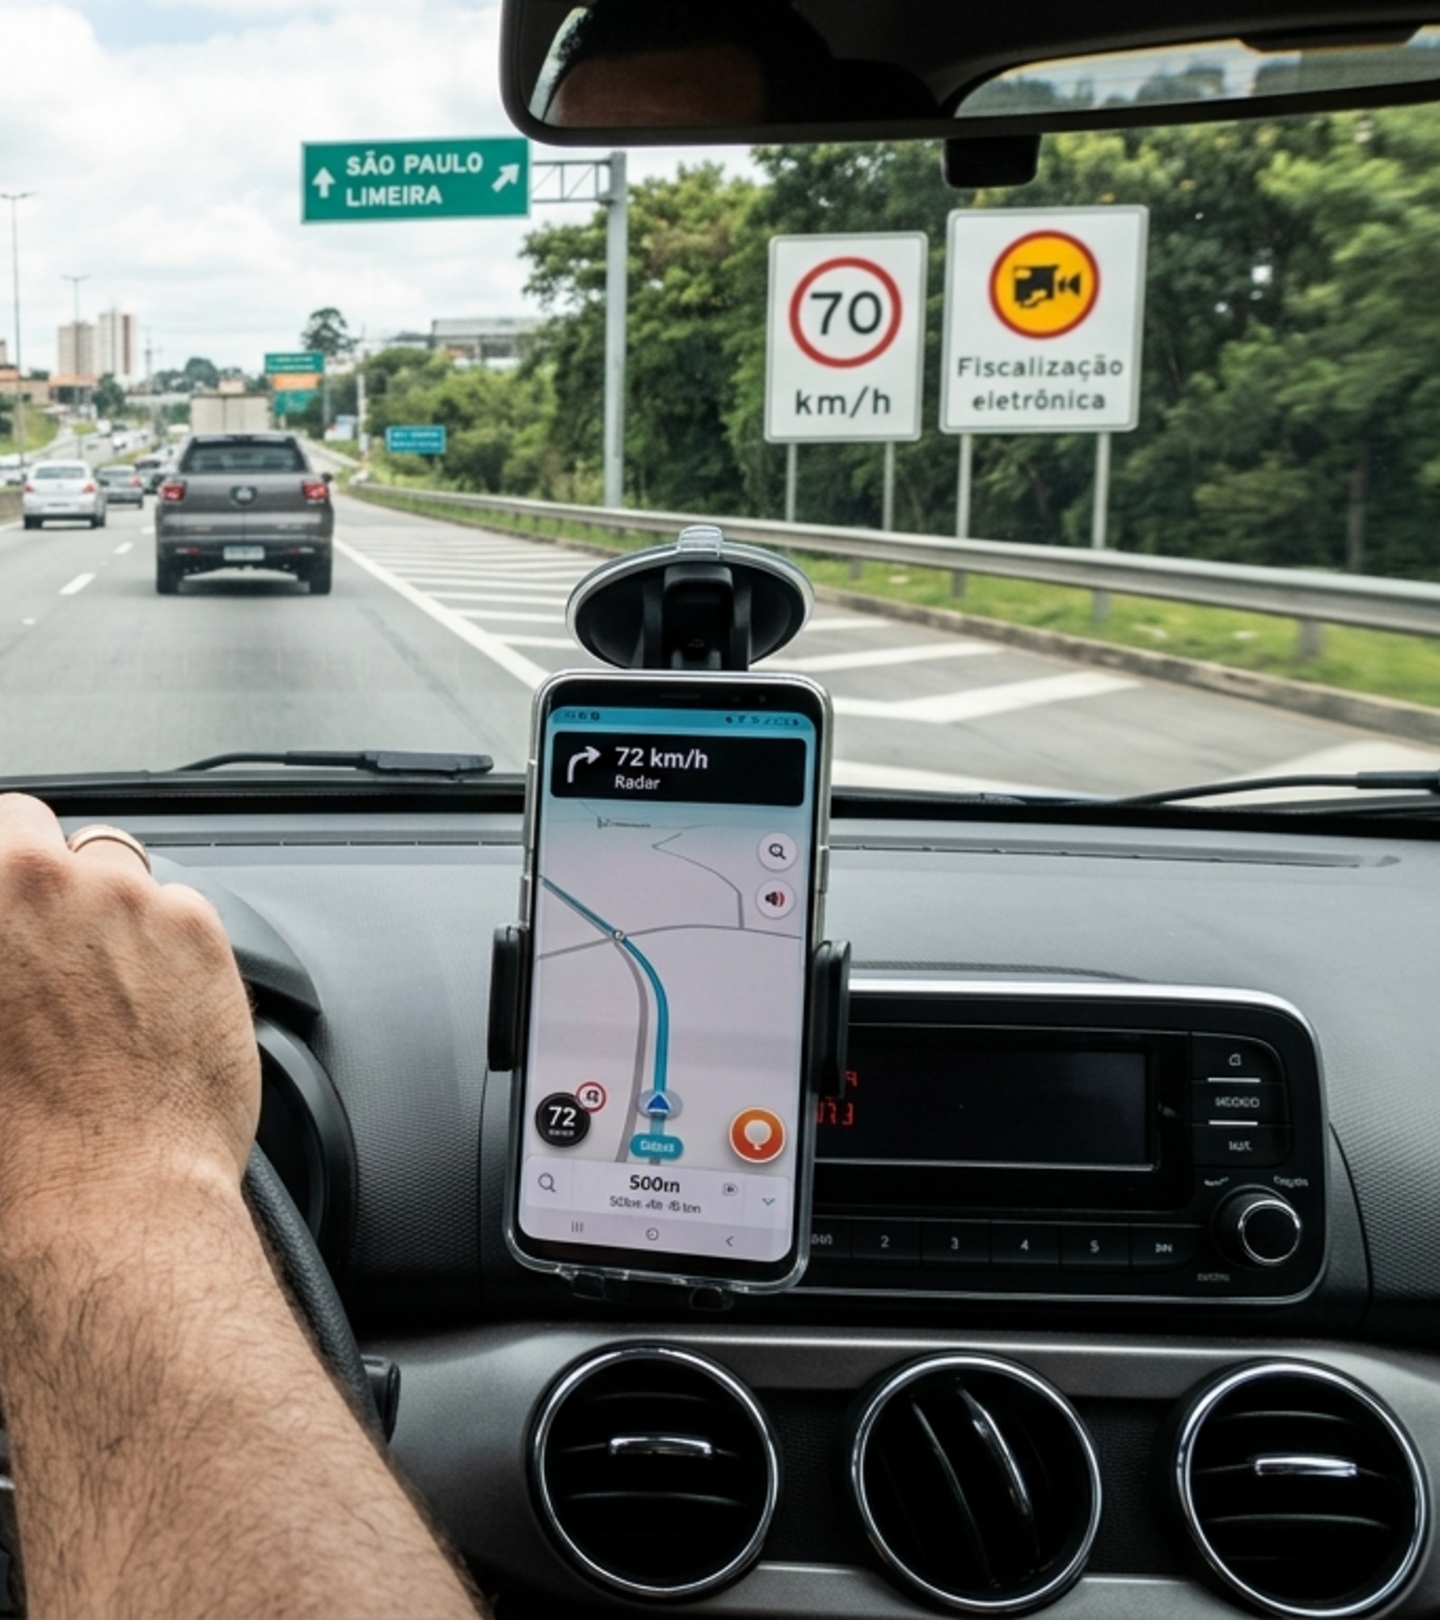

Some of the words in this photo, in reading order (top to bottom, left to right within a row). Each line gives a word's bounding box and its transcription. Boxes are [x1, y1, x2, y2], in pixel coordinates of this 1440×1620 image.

[346, 150, 395, 176] SÃO
[404, 152, 483, 174] PAULO
[346, 185, 443, 207] LIMEIRA
[810, 291, 883, 335] 70
[958, 354, 1123, 382] Fiscalização
[795, 386, 891, 418] km/h
[615, 747, 644, 767] 72
[650, 748, 708, 770] km/h
[614, 774, 660, 790] Radar
[549, 1106, 577, 1127] 72
[880, 1235, 890, 1248] 2
